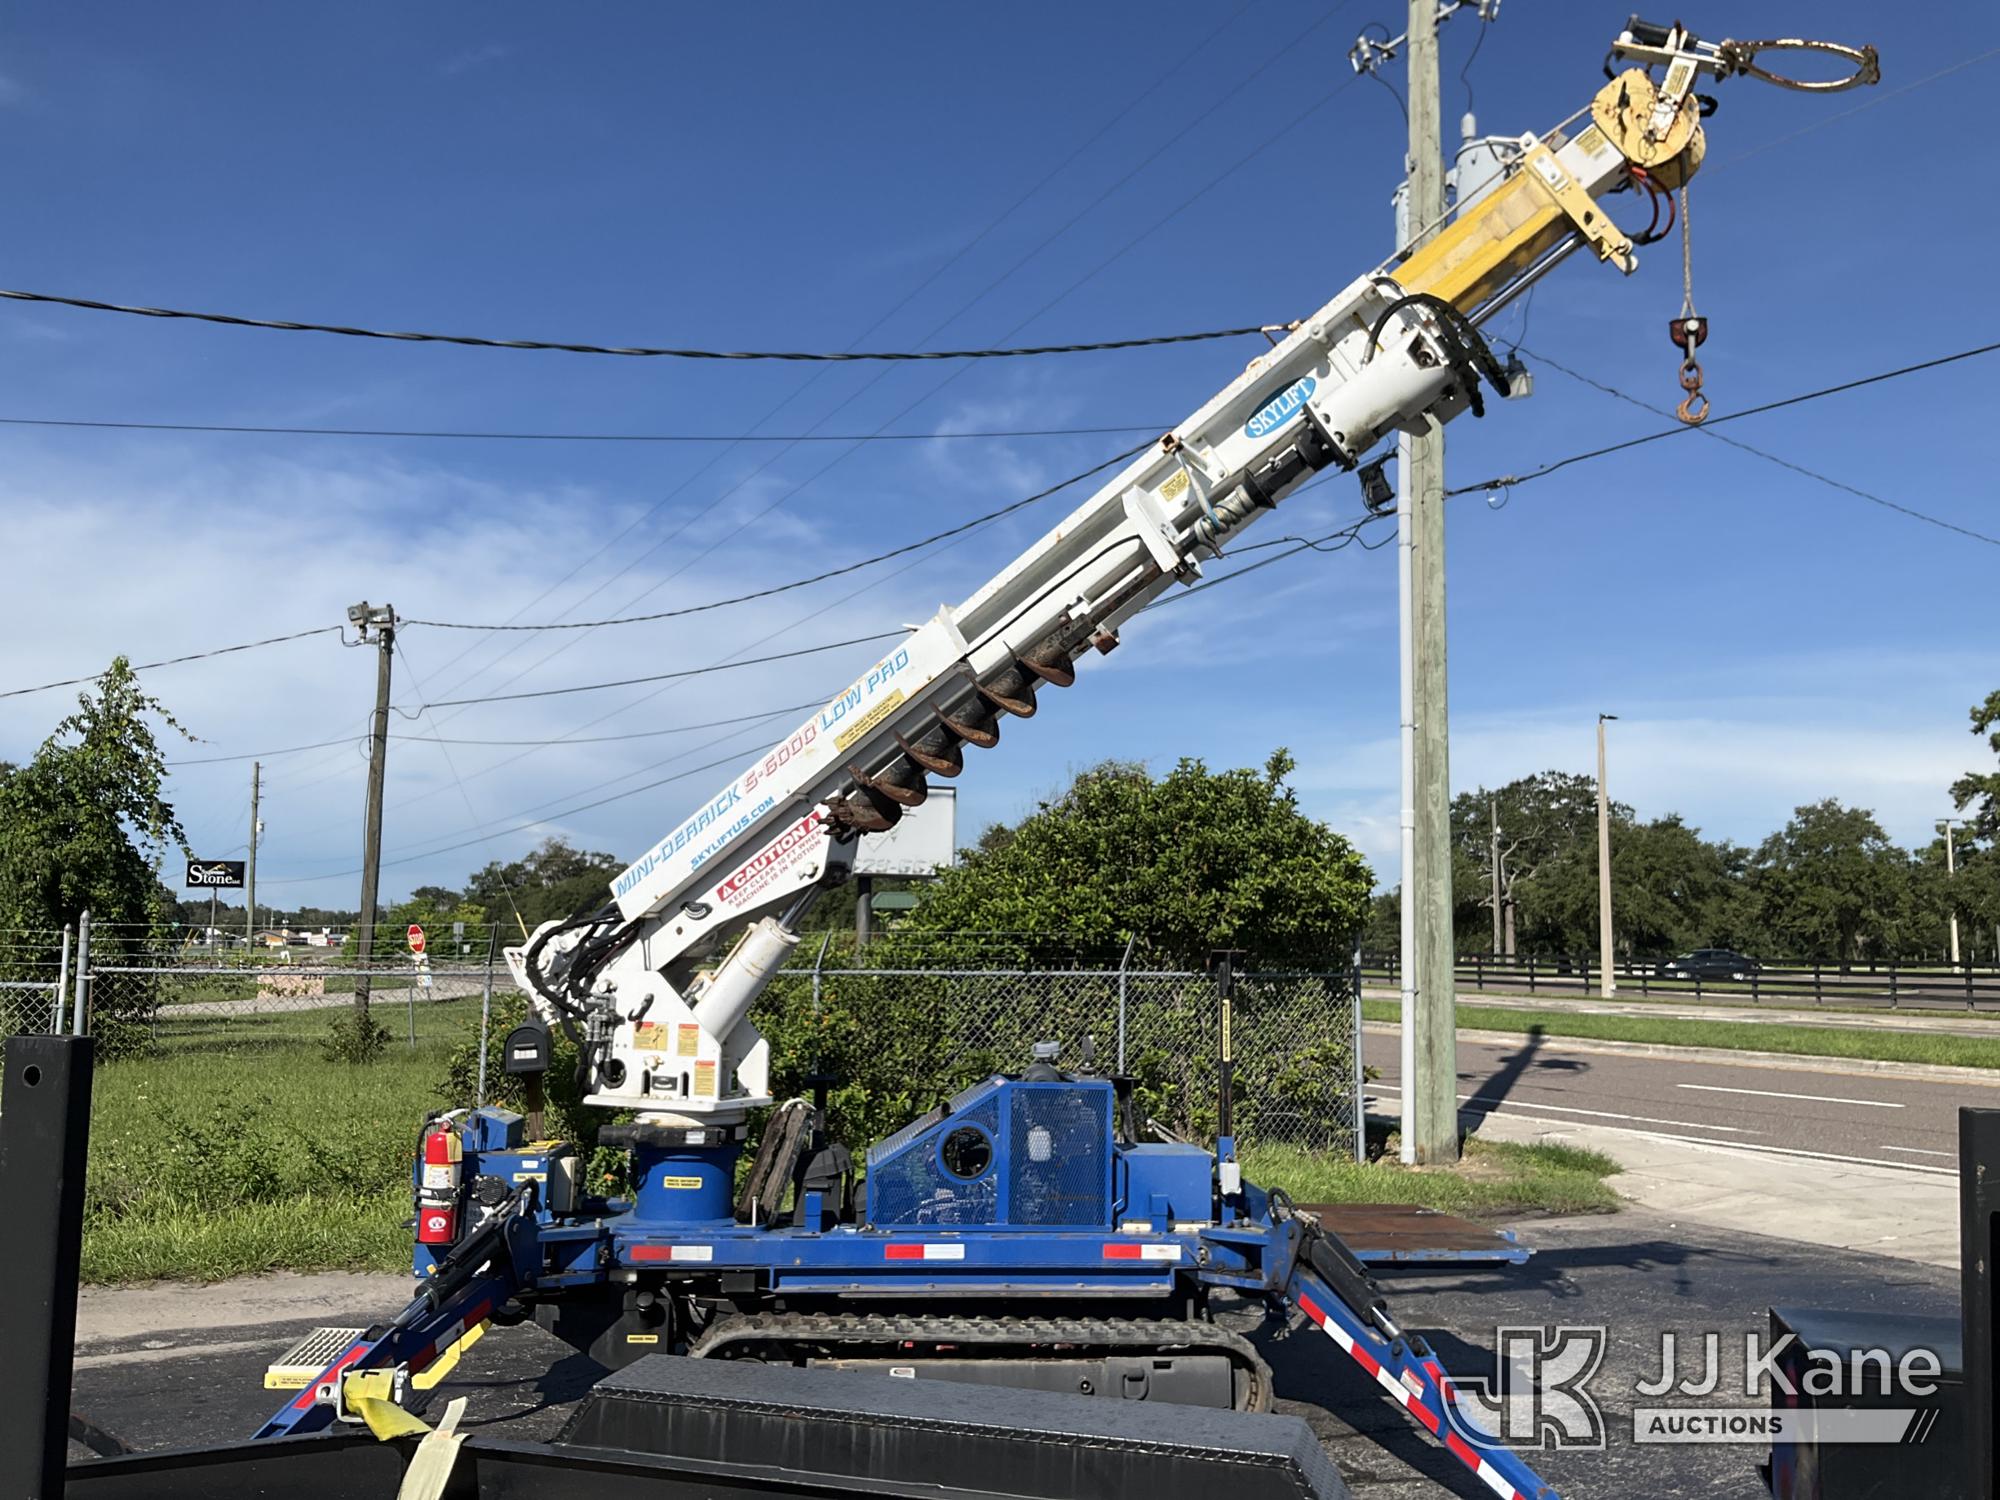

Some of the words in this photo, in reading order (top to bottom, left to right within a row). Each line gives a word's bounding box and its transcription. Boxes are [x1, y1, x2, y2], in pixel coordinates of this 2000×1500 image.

[1248, 378, 1311, 434] SKYLIFT
[616, 784, 742, 898] MINI-DERRICK
[744, 723, 818, 794] S-6000
[820, 685, 862, 731] LOW
[867, 649, 909, 694] PRO
[691, 796, 775, 867] SKYLIFTUS.COM
[733, 824, 807, 888] CAUTION
[189, 865, 233, 884] Stone
[728, 886, 748, 904] KEEP
[750, 865, 776, 887] CLEAR
[786, 849, 796, 859] FT
[798, 828, 822, 849] WHEN
[735, 880, 769, 908] MACHINE
[770, 872, 779, 881] IS
[780, 865, 788, 874] IN
[790, 840, 821, 865] MOTION
